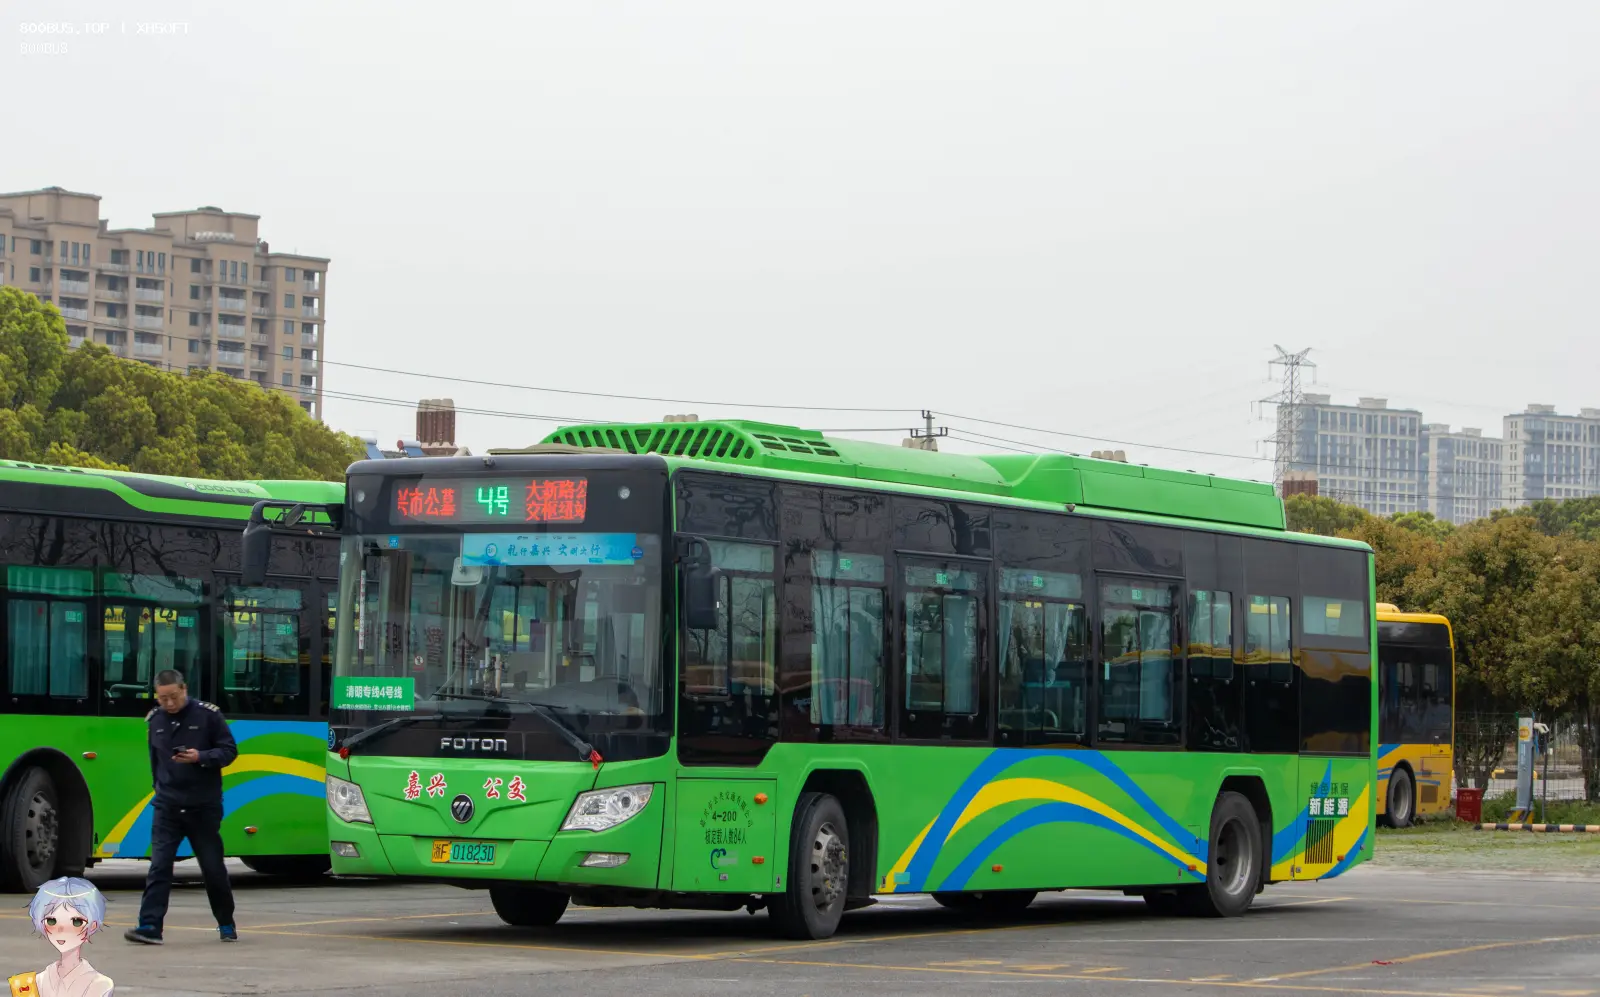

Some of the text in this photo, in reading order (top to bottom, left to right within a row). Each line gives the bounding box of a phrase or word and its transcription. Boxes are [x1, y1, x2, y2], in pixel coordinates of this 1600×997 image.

[477, 486, 510, 515] 4号
[345, 685, 403, 699] 清明专线4号线
[440, 737, 508, 752] FOTON
[403, 770, 527, 803] 嘉兴 公交
[1310, 782, 1349, 795] 绿色环保
[1309, 797, 1349, 815] 新能源
[712, 811, 737, 822] 4-200
[705, 828, 747, 845] 核定载人数84人
